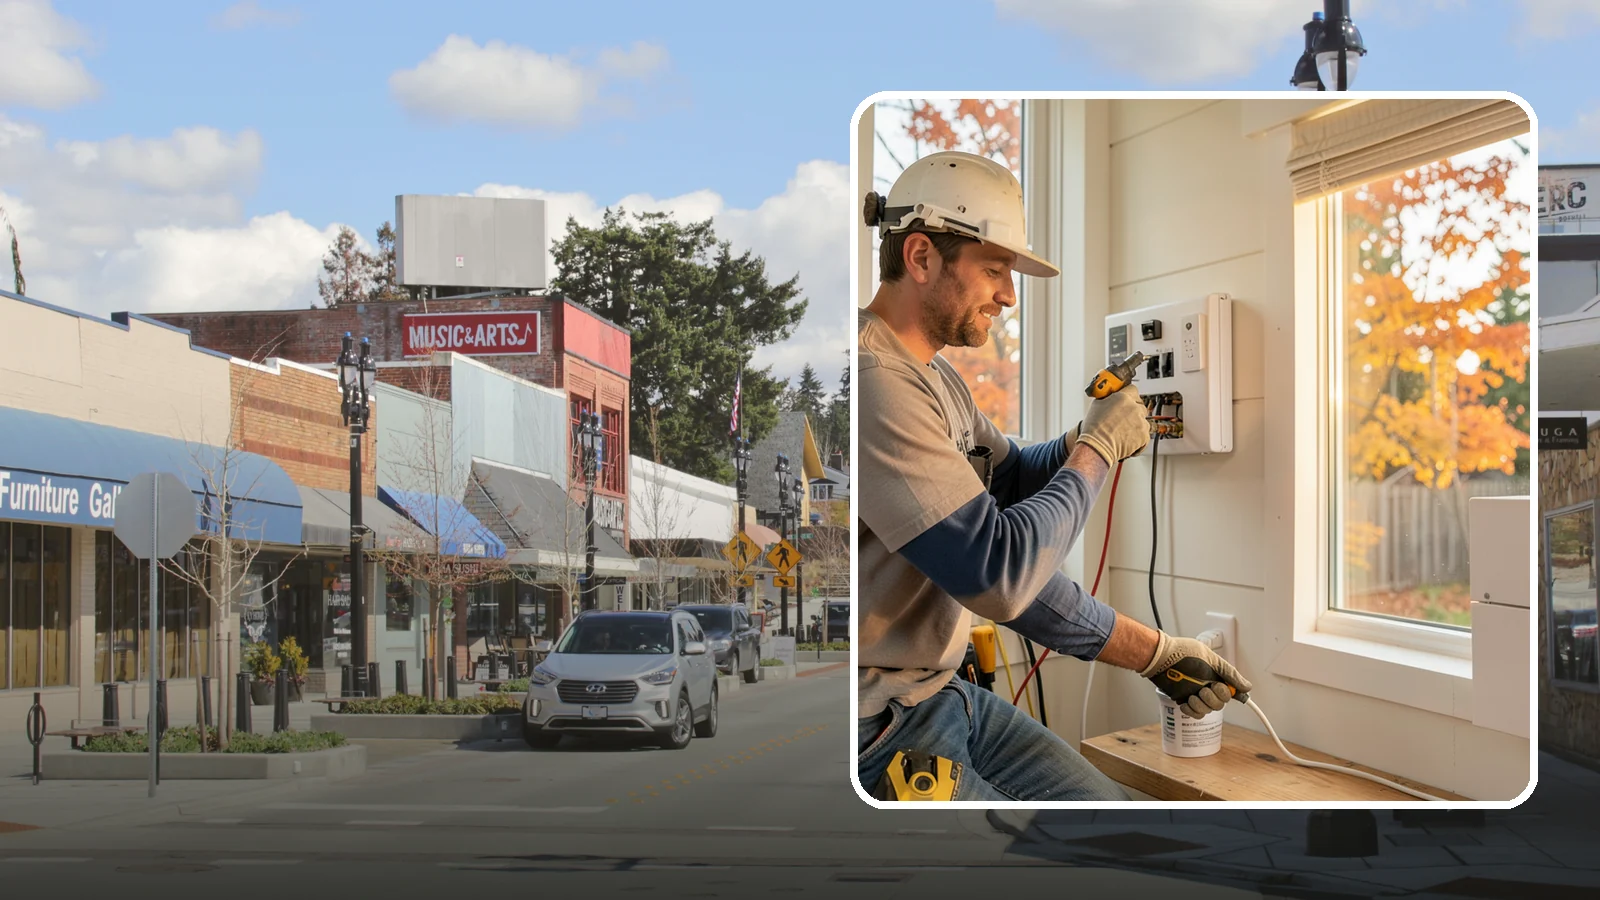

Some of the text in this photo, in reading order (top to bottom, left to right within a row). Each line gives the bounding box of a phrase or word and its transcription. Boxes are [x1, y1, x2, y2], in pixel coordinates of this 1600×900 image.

[409, 323, 519, 349] MUSIC&ARTS
[1540, 427, 1577, 437] UGA
[0, 471, 122, 519] Furniture Gal
[453, 563, 480, 574] SUSHI
